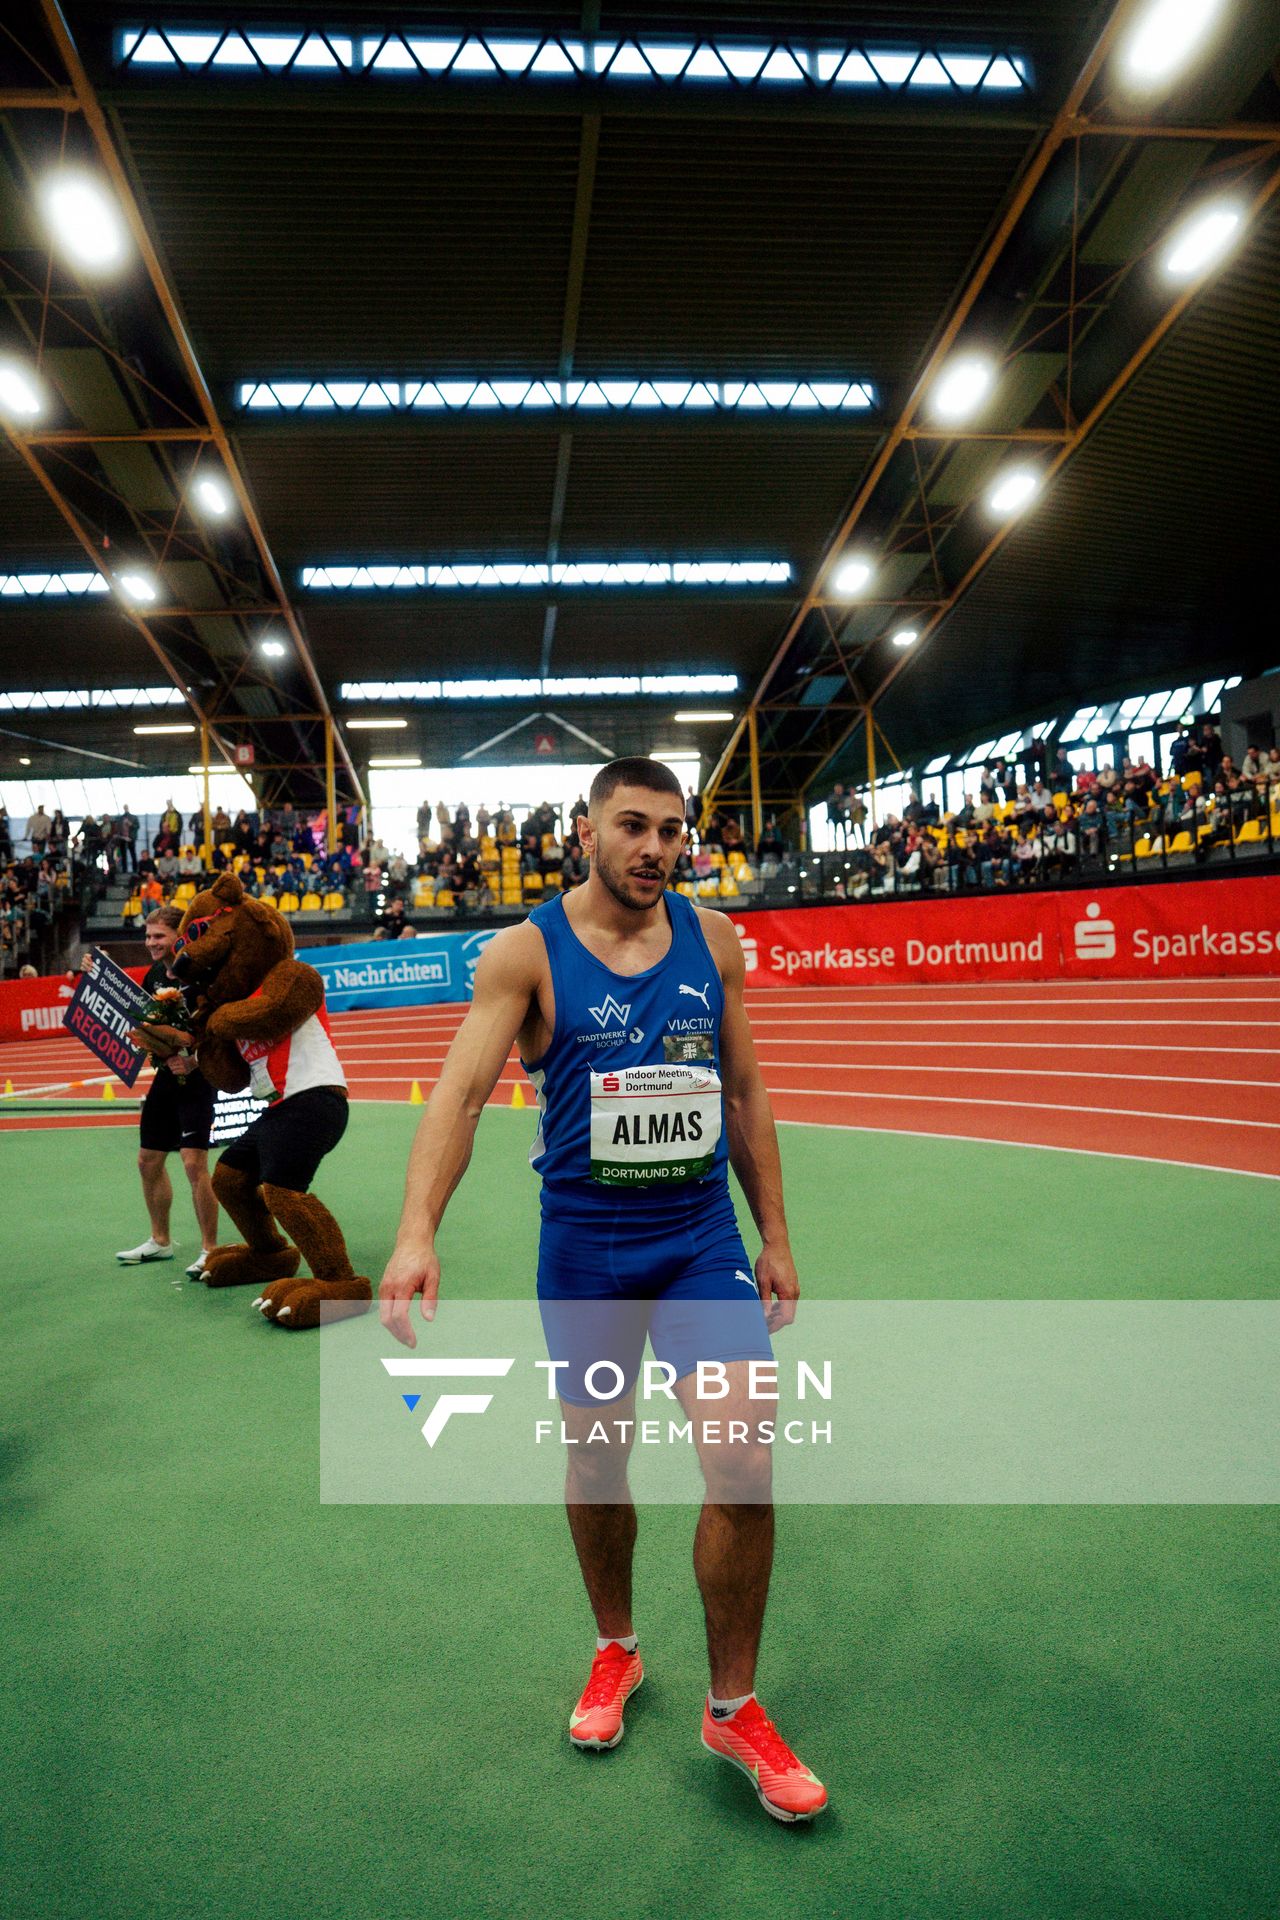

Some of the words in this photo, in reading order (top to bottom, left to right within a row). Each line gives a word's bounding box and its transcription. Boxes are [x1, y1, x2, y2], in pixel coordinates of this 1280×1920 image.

[239, 746, 250, 761] B
[770, 942, 895, 976] Sparkasse
[906, 932, 1043, 966] Dortmund
[334, 960, 444, 988] Nachrichten
[99, 977, 131, 1010] Dortmund
[103, 966, 125, 990] Indoor
[123, 984, 147, 1013] Meetin
[21, 1005, 69, 1032] PUM
[667, 1017, 715, 1031] VIACTIV
[71, 1005, 136, 1076] RECORD!
[576, 1030, 627, 1043] STADTWERKE
[596, 1039, 627, 1049] BOCHUM
[625, 1070, 657, 1079] Indoor
[658, 1069, 693, 1079] Meeting
[625, 1081, 673, 1092] Dortmund
[214, 1113, 246, 1127] ALMAS
[611, 1110, 703, 1145] ALMAS
[602, 1167, 670, 1179] DORTMUND
[671, 1166, 687, 1177] 26
